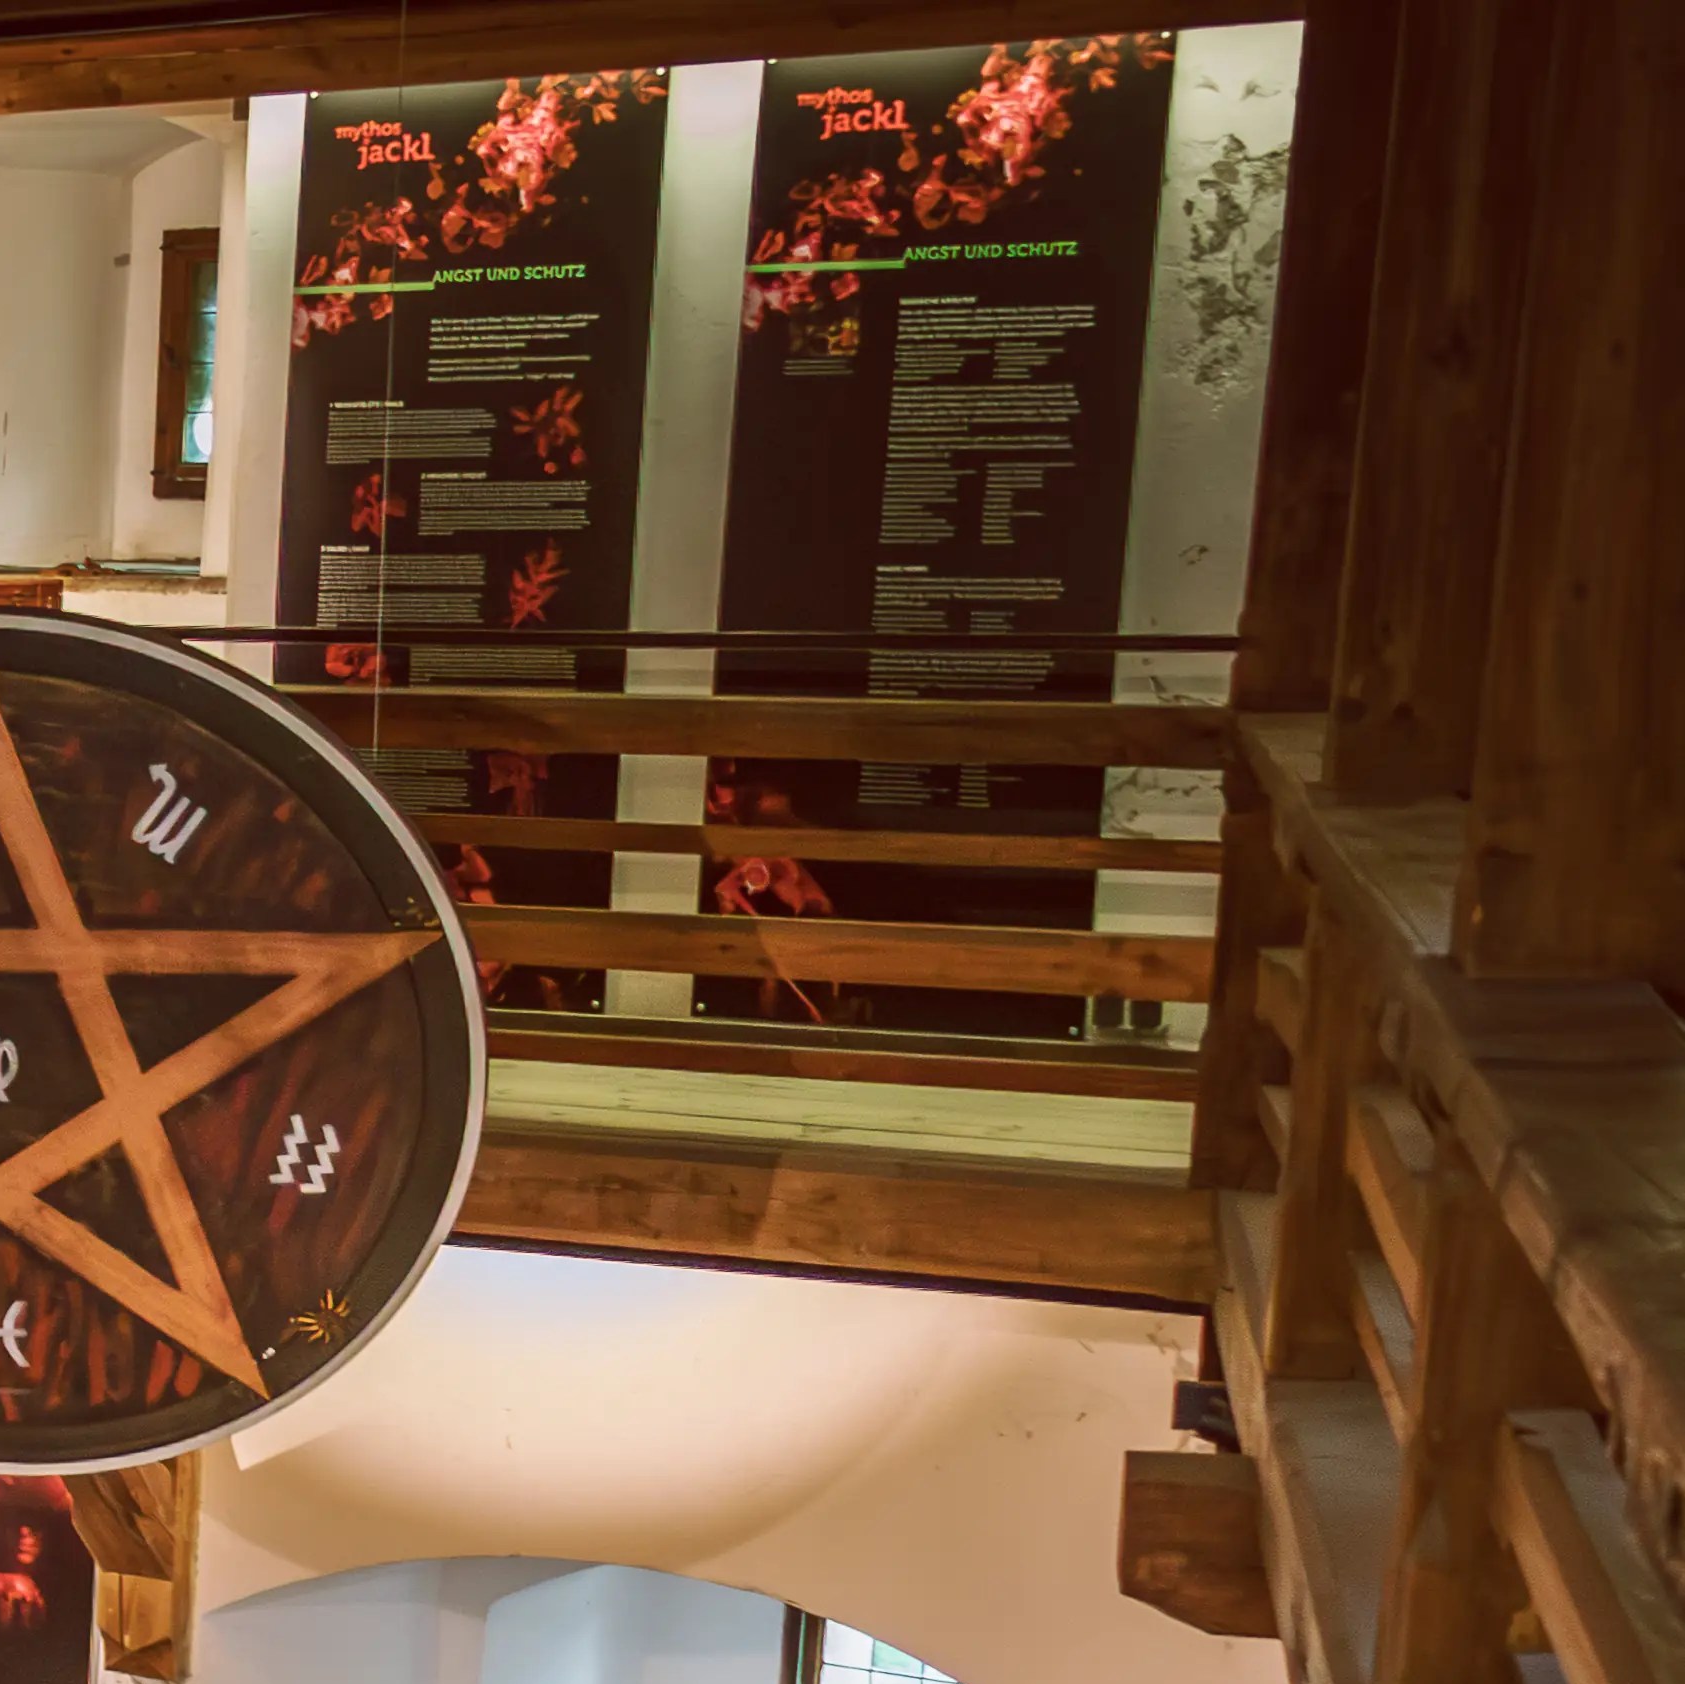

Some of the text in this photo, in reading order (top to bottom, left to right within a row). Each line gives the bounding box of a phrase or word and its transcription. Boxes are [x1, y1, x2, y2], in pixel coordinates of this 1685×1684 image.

[797, 86, 873, 109] mythos
[335, 120, 402, 142] mythos
[820, 100, 909, 140] jackl
[357, 131, 436, 170] jackl
[904, 241, 1079, 260] ANGST UND SCHUTZ
[433, 264, 586, 283] ANGST UND SCHUTZ
